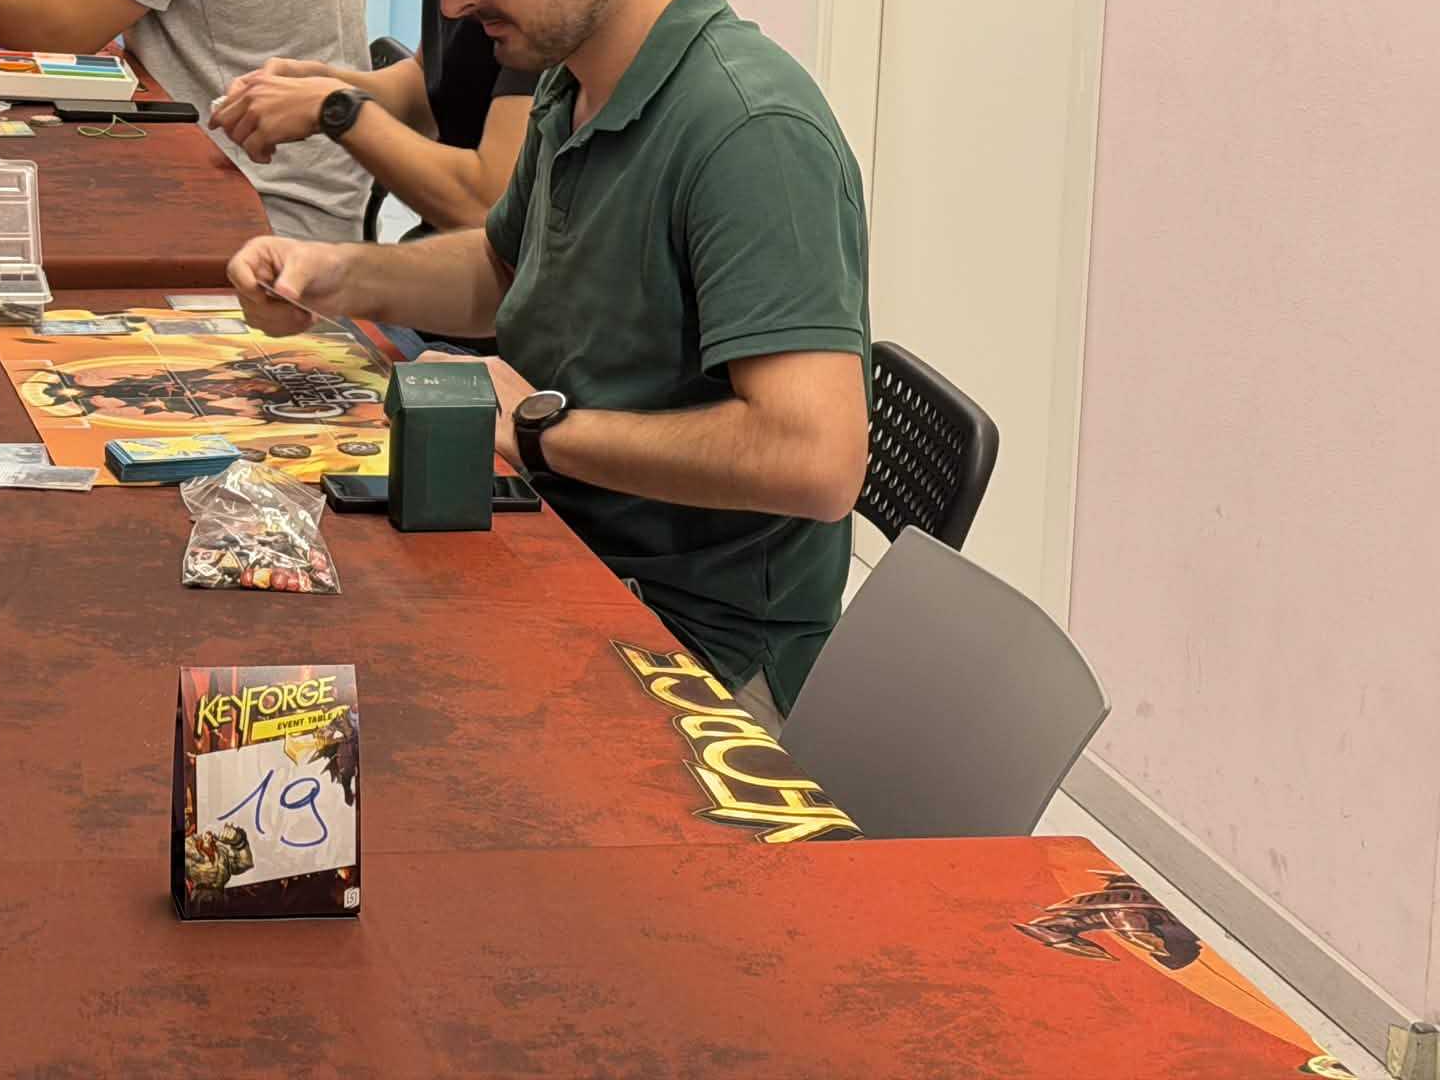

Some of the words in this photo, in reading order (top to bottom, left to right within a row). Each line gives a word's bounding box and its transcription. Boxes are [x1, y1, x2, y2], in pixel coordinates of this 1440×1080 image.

[197, 676, 336, 744] KEYFORGE
[277, 718, 305, 730] EVENT
[307, 713, 332, 724] TABLE
[217, 770, 329, 848] 19
